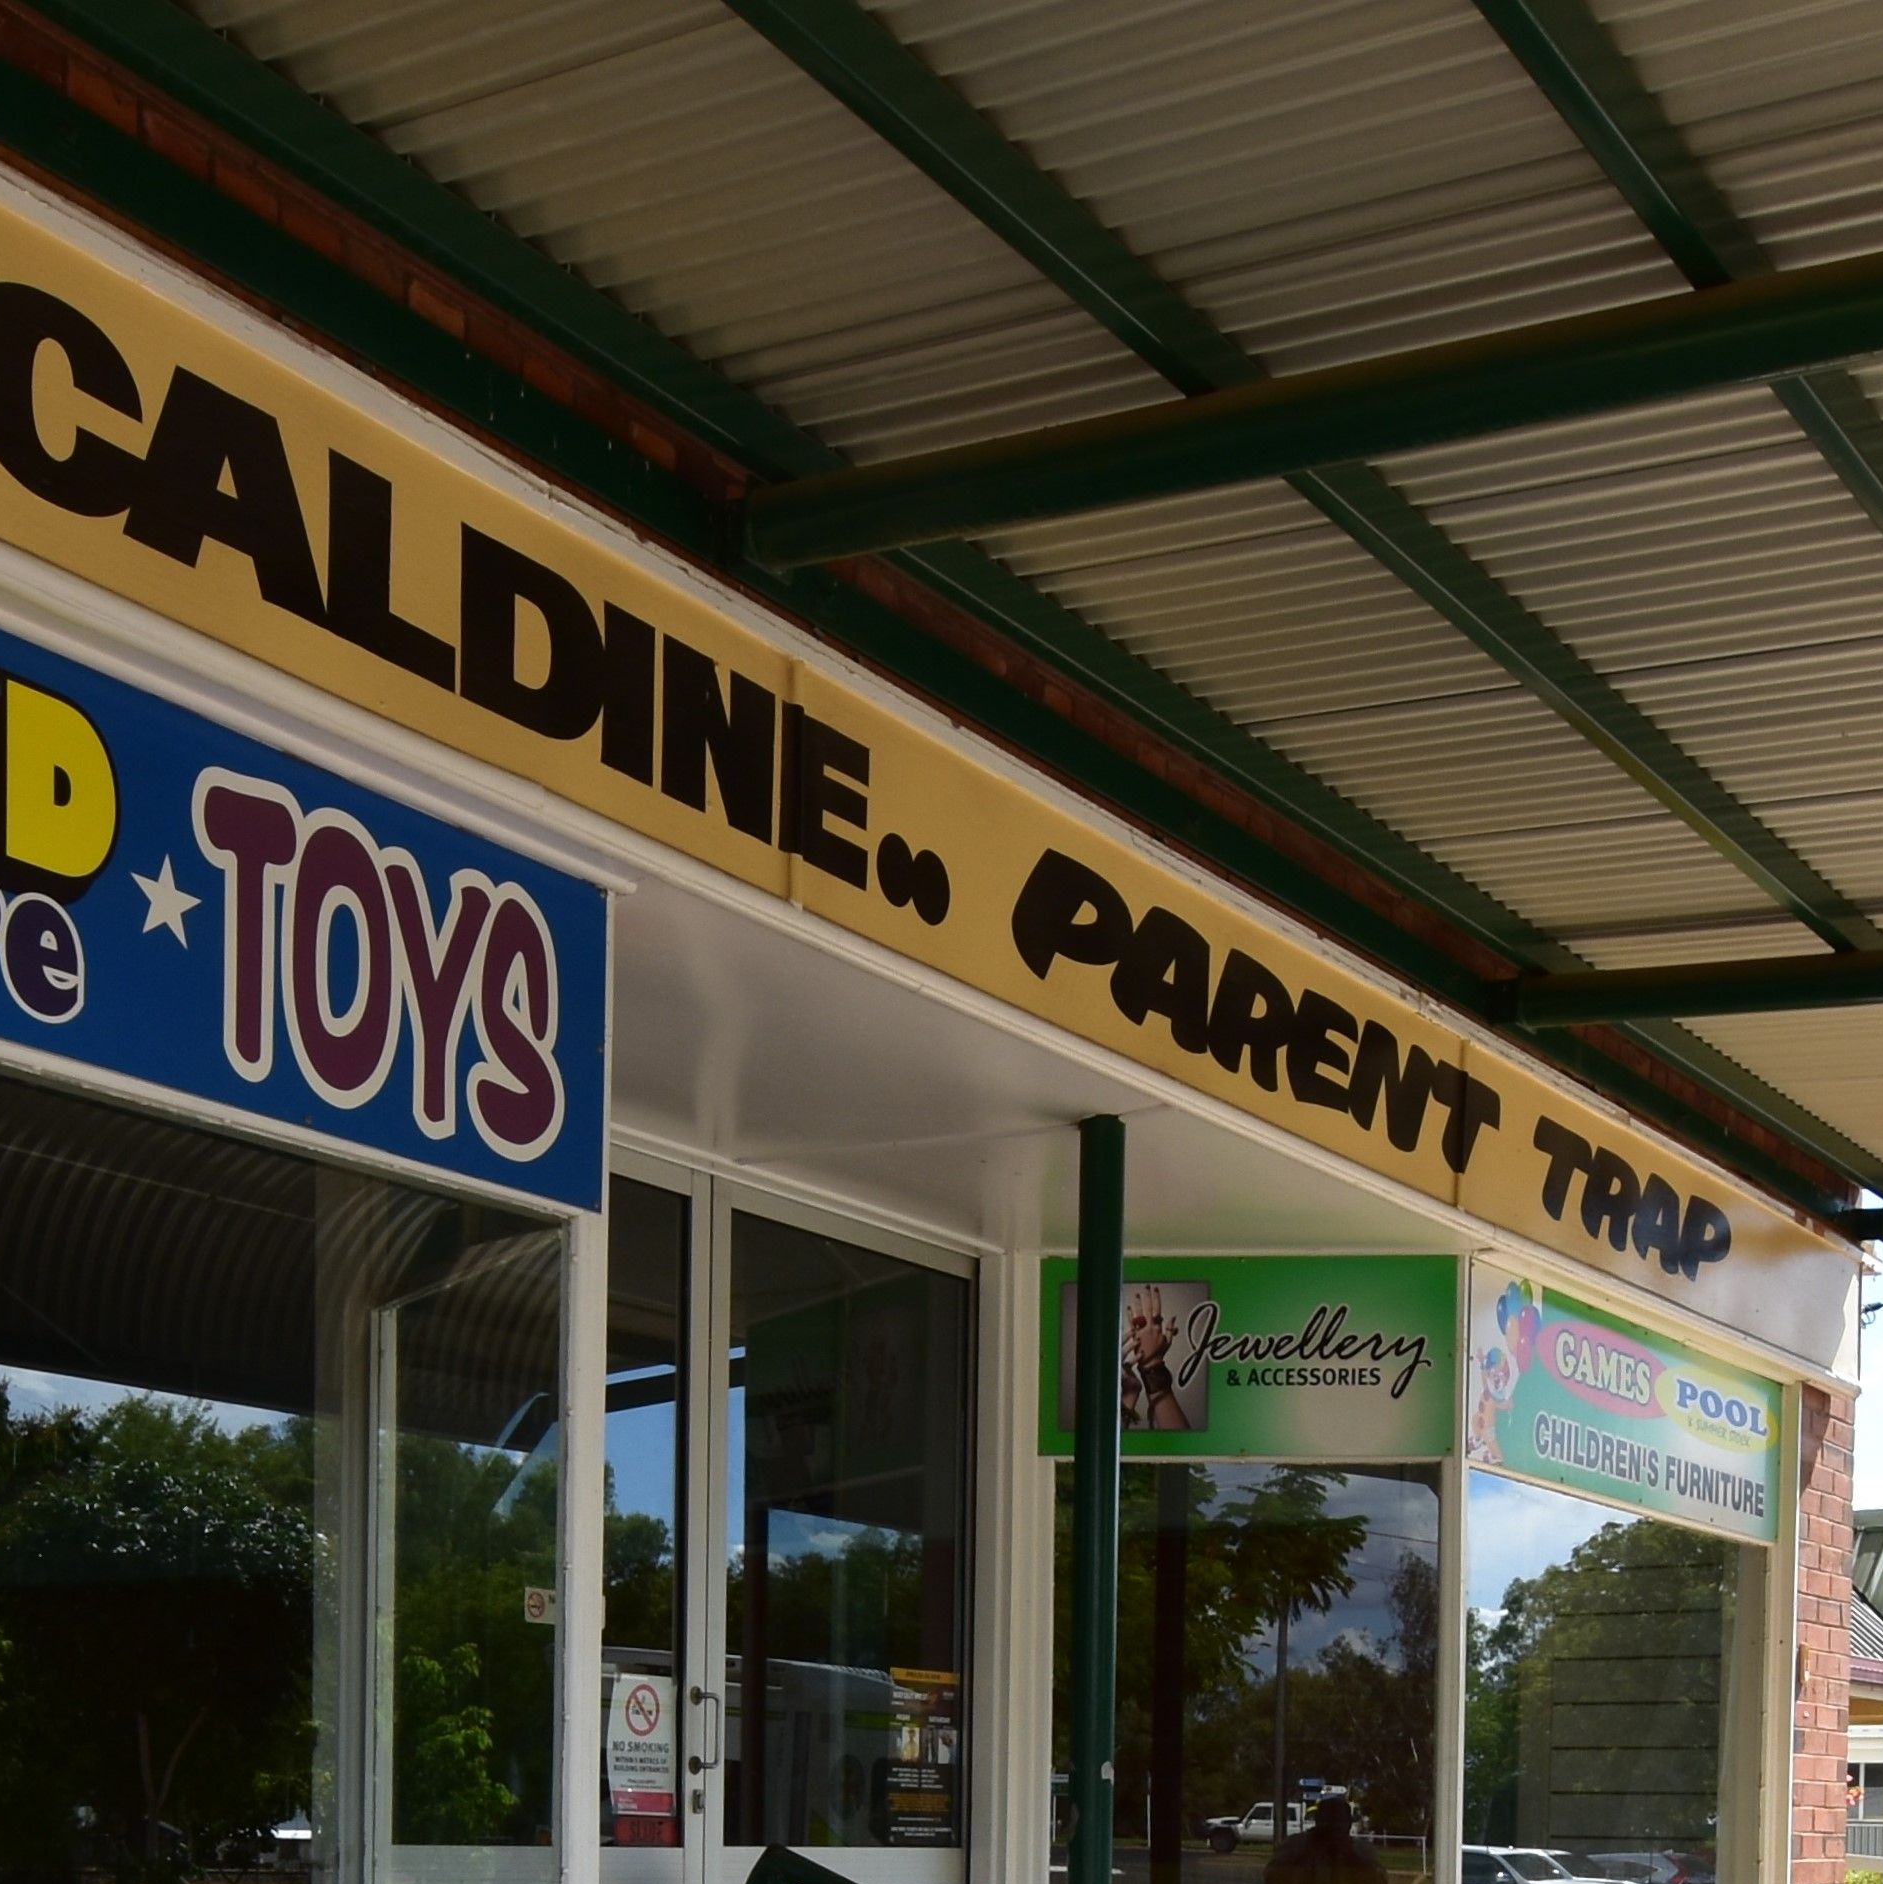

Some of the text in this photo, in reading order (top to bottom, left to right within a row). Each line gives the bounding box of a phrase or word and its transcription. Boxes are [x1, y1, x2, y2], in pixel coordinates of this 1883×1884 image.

[193, 766, 564, 1163] TOYS
[1011, 846, 1500, 1175] PARENT
[1532, 1127, 1733, 1282] TRAP
[1178, 1301, 1432, 1399] Jewellery
[1226, 1367, 1382, 1387] & ACCESSORIES
[1554, 1329, 1652, 1407] GAMES
[1675, 1377, 1768, 1438] POOL
[1533, 1412, 1765, 1518] CHILDREN'S FURNITURE
[612, 1740, 670, 1754] NO SMOKING
